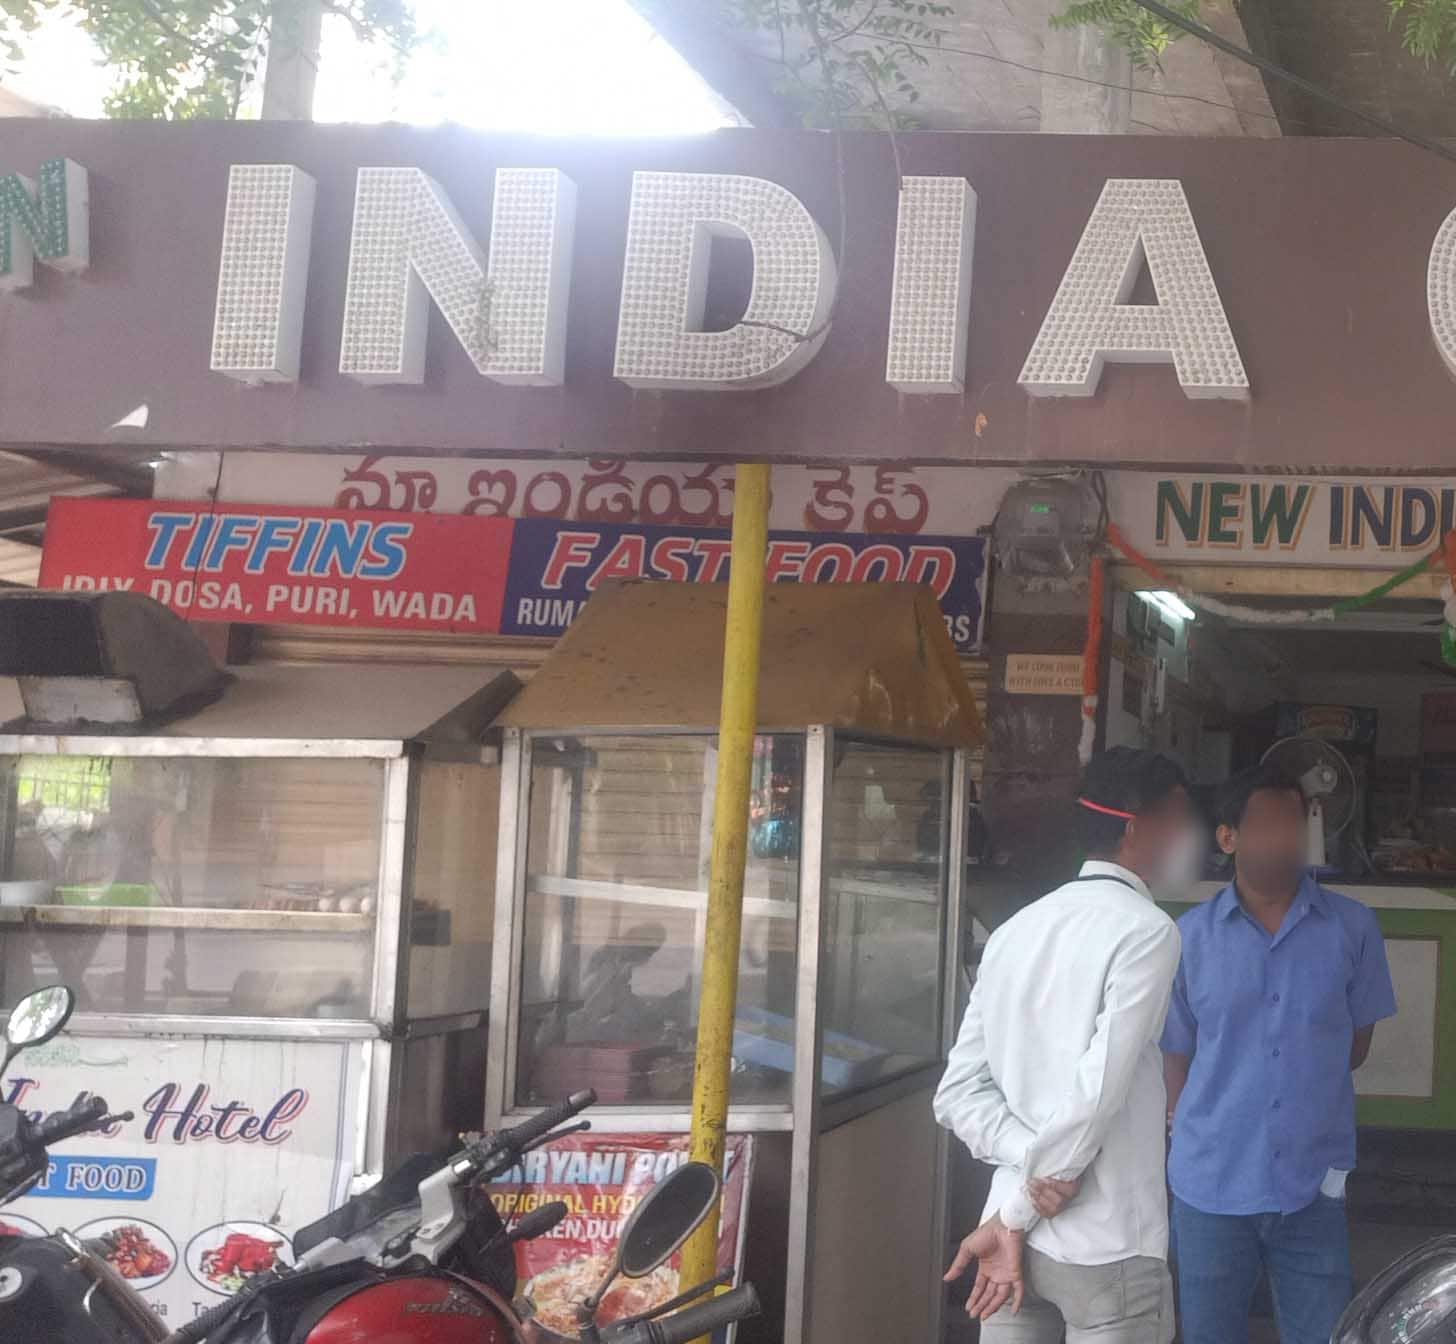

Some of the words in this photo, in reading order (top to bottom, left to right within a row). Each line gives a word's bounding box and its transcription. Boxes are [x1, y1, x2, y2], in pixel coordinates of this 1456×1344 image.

[210, 164, 1251, 400] INDIA
[143, 511, 412, 580] TIFFINS
[1154, 479, 1317, 550] NEW
[150, 577, 254, 614] DOSA,
[266, 585, 359, 620] PURI,
[372, 590, 478, 623] WADA
[541, 531, 735, 590] FAST
[767, 543, 957, 601] FOOD
[143, 1081, 310, 1146] Hotel
[64, 1164, 147, 1193] FOOD
